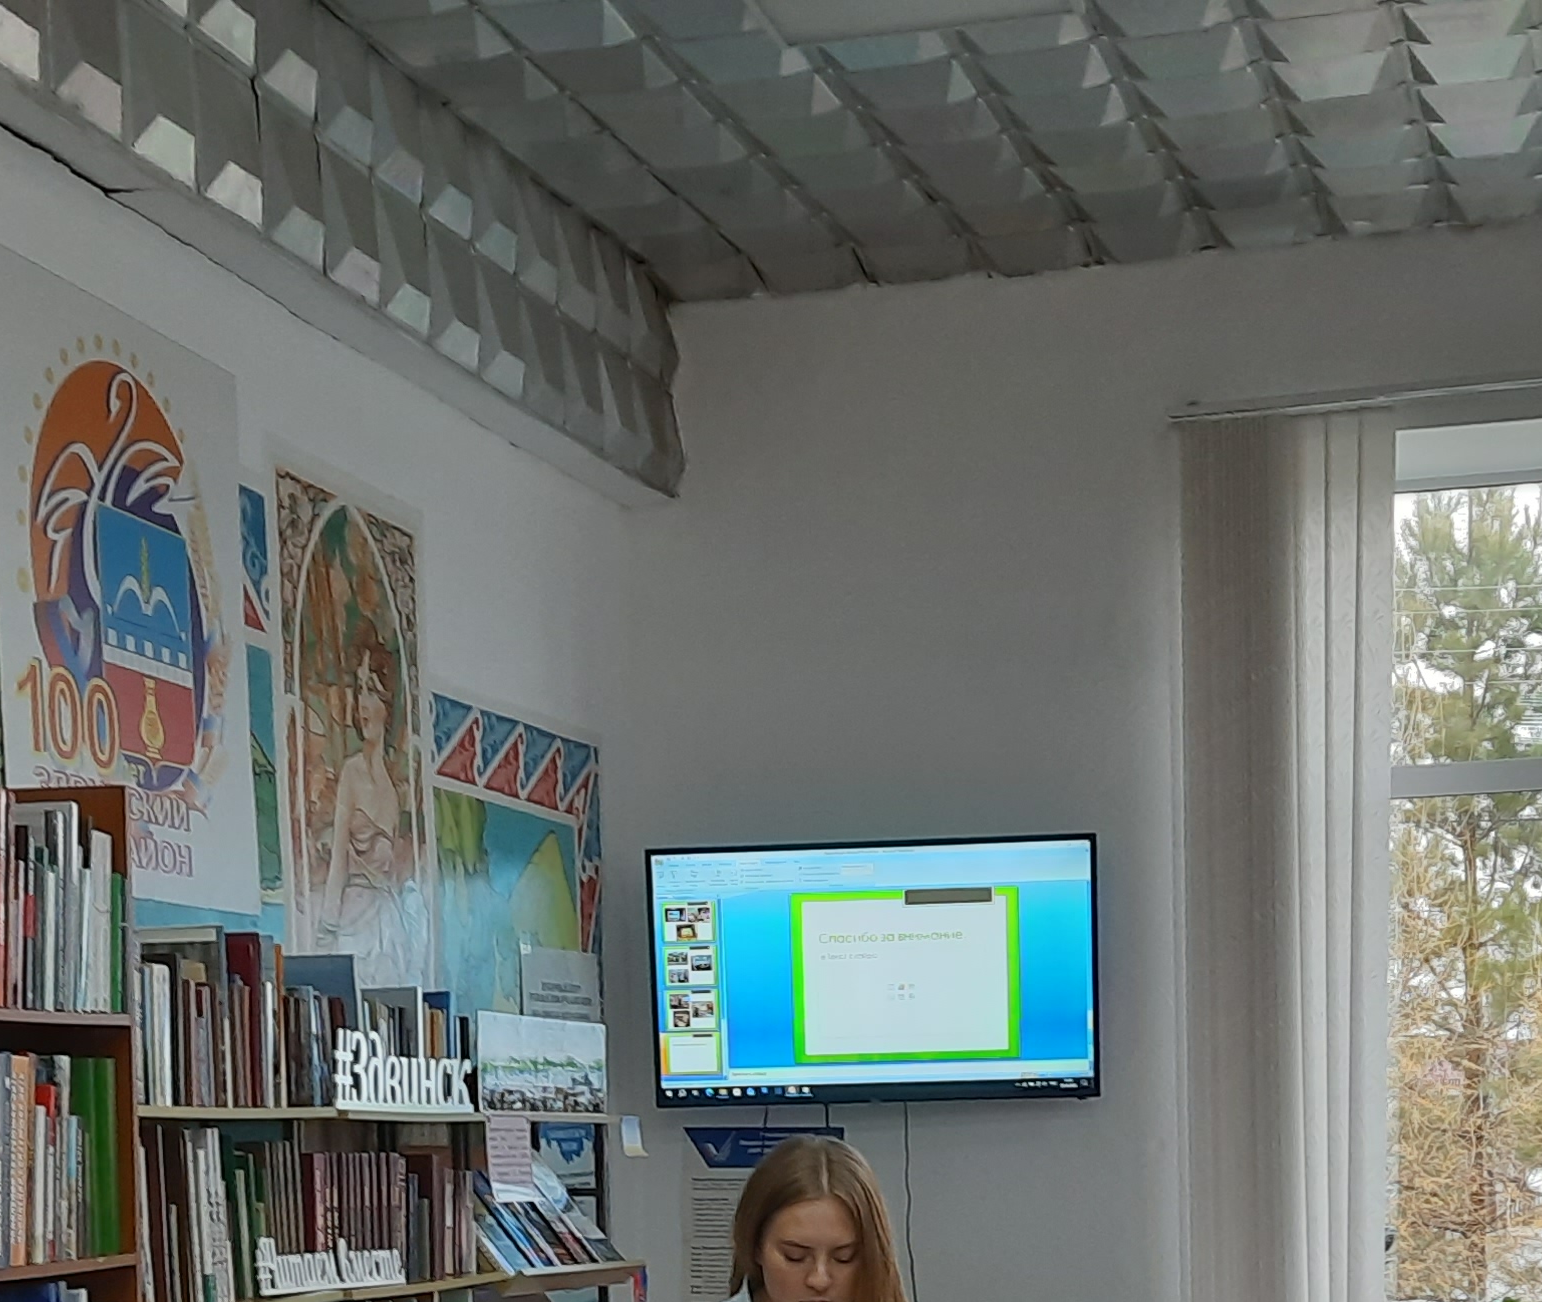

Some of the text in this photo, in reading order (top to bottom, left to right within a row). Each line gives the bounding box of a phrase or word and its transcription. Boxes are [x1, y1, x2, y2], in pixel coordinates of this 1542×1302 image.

[17, 657, 120, 773] 100
[130, 836, 193, 877] АЙОН
[819, 931, 878, 944] Спасибо
[881, 932, 895, 942] за
